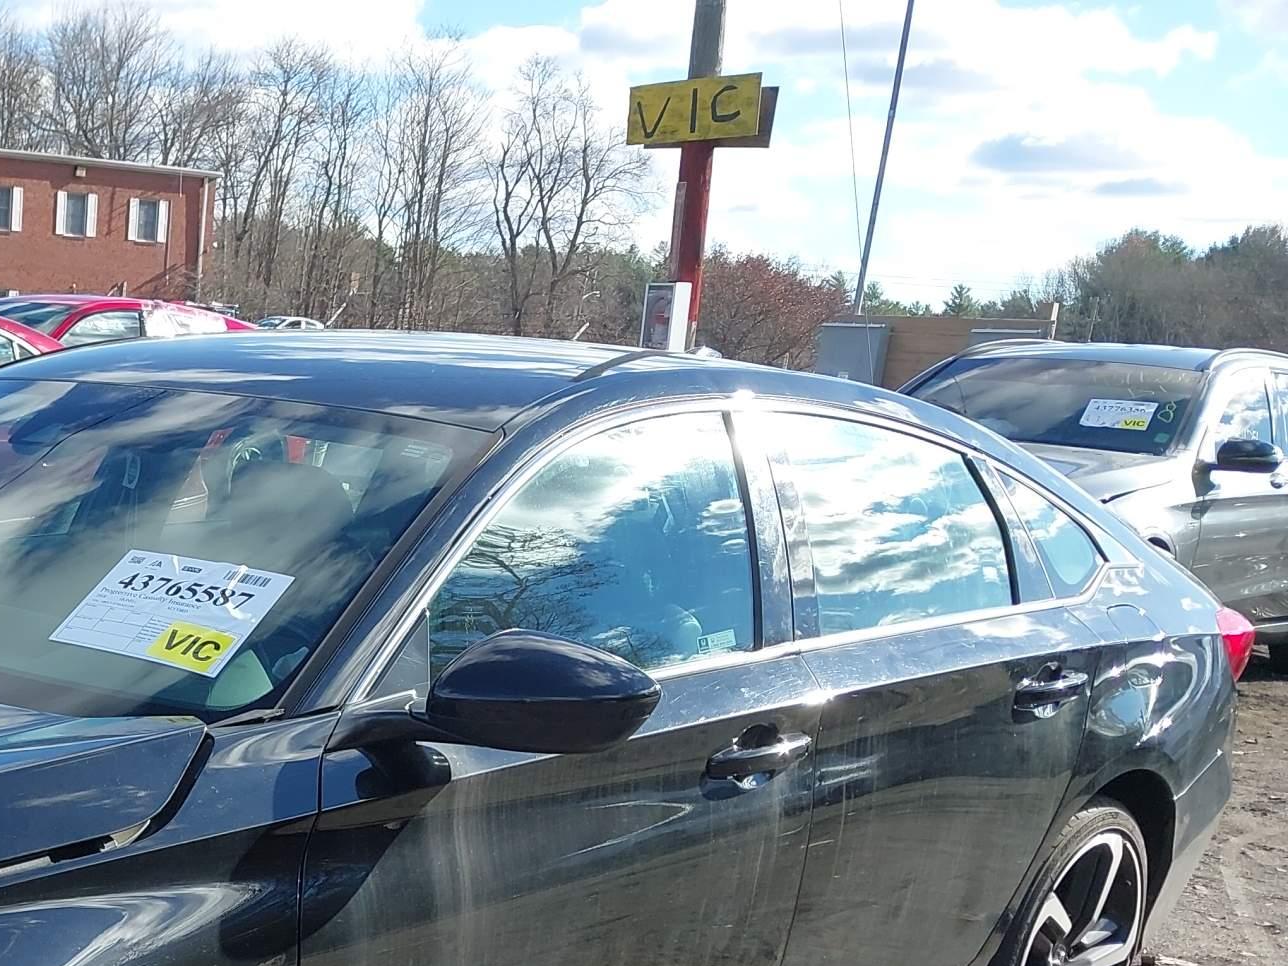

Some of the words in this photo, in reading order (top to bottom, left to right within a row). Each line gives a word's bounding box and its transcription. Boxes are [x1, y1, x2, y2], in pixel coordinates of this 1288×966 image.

[637, 85, 740, 138] VIC
[1124, 419, 1146, 427] VIC
[118, 572, 255, 610] 43765587
[165, 629, 221, 661] VIC
